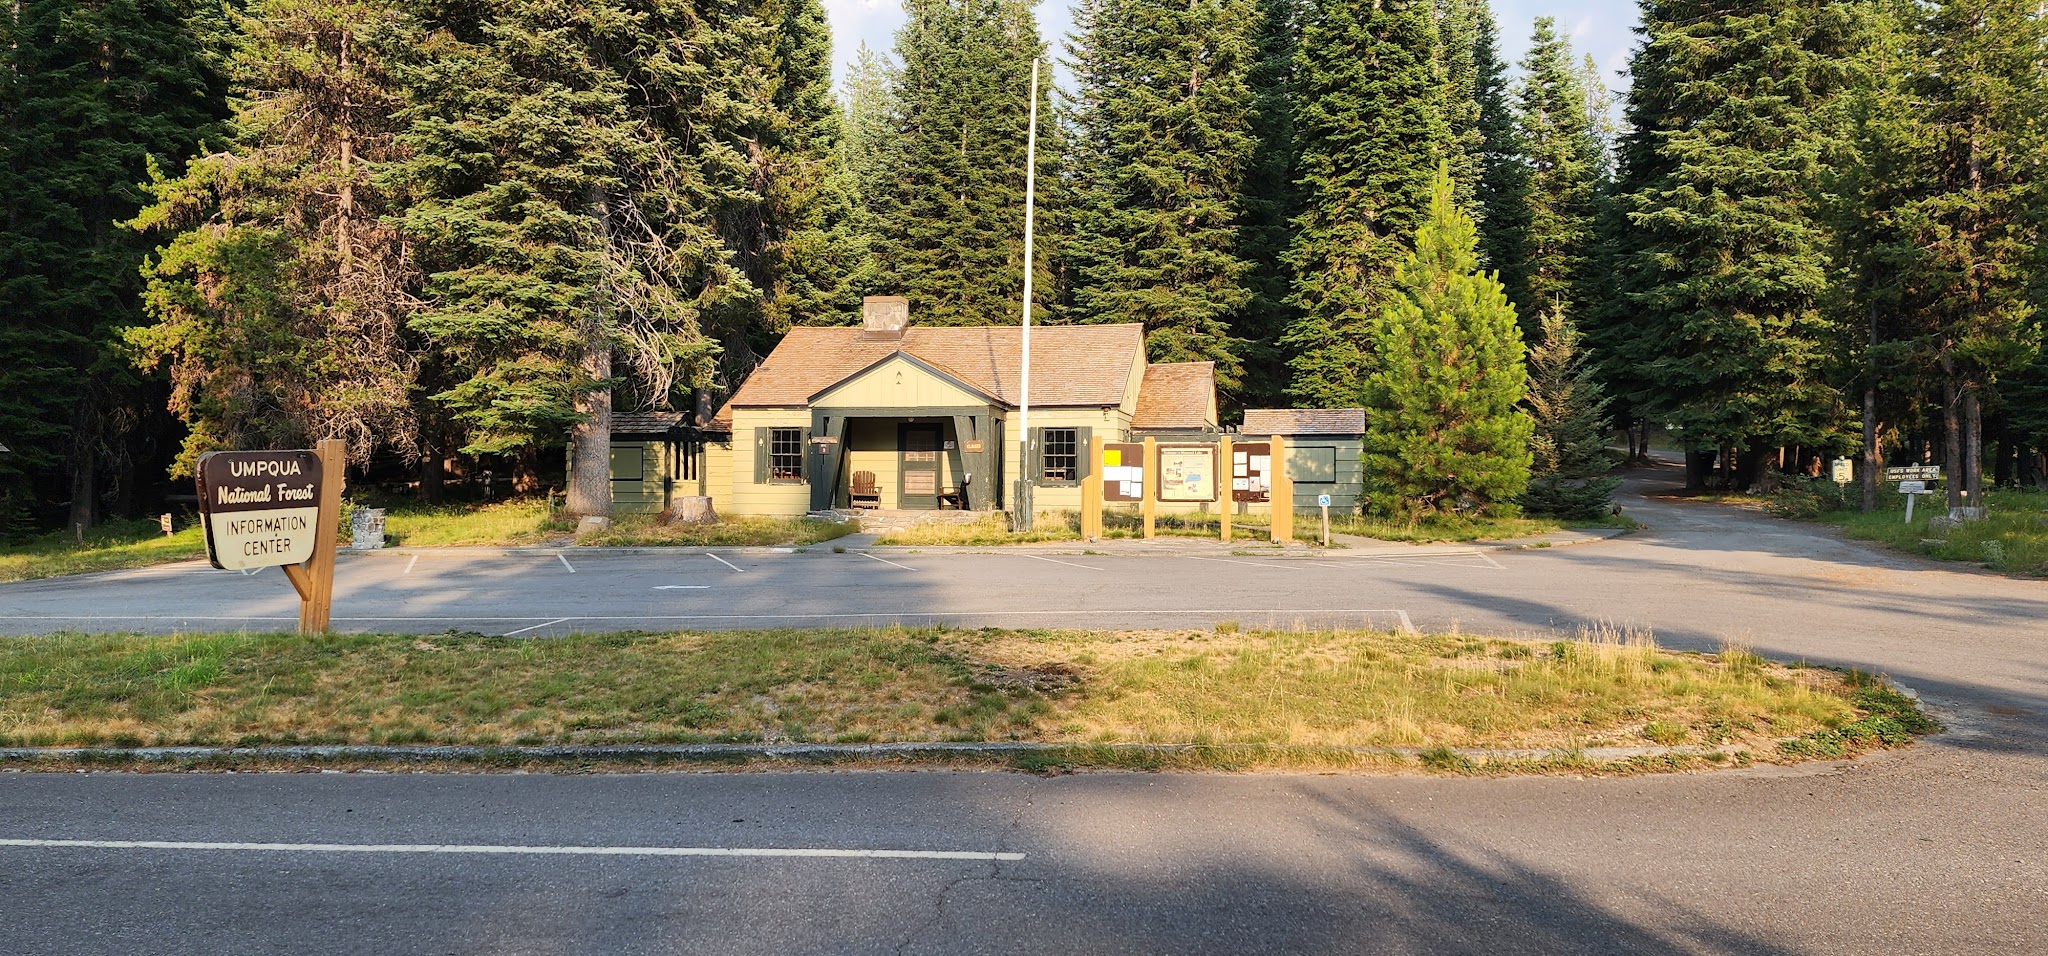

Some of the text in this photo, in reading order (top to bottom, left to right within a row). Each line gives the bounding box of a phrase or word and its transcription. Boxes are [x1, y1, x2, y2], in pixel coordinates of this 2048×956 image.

[230, 460, 302, 478] UMPQUA
[217, 482, 315, 505] National Forest
[226, 516, 307, 536] INFORMATION
[243, 538, 292, 556] CENTER
